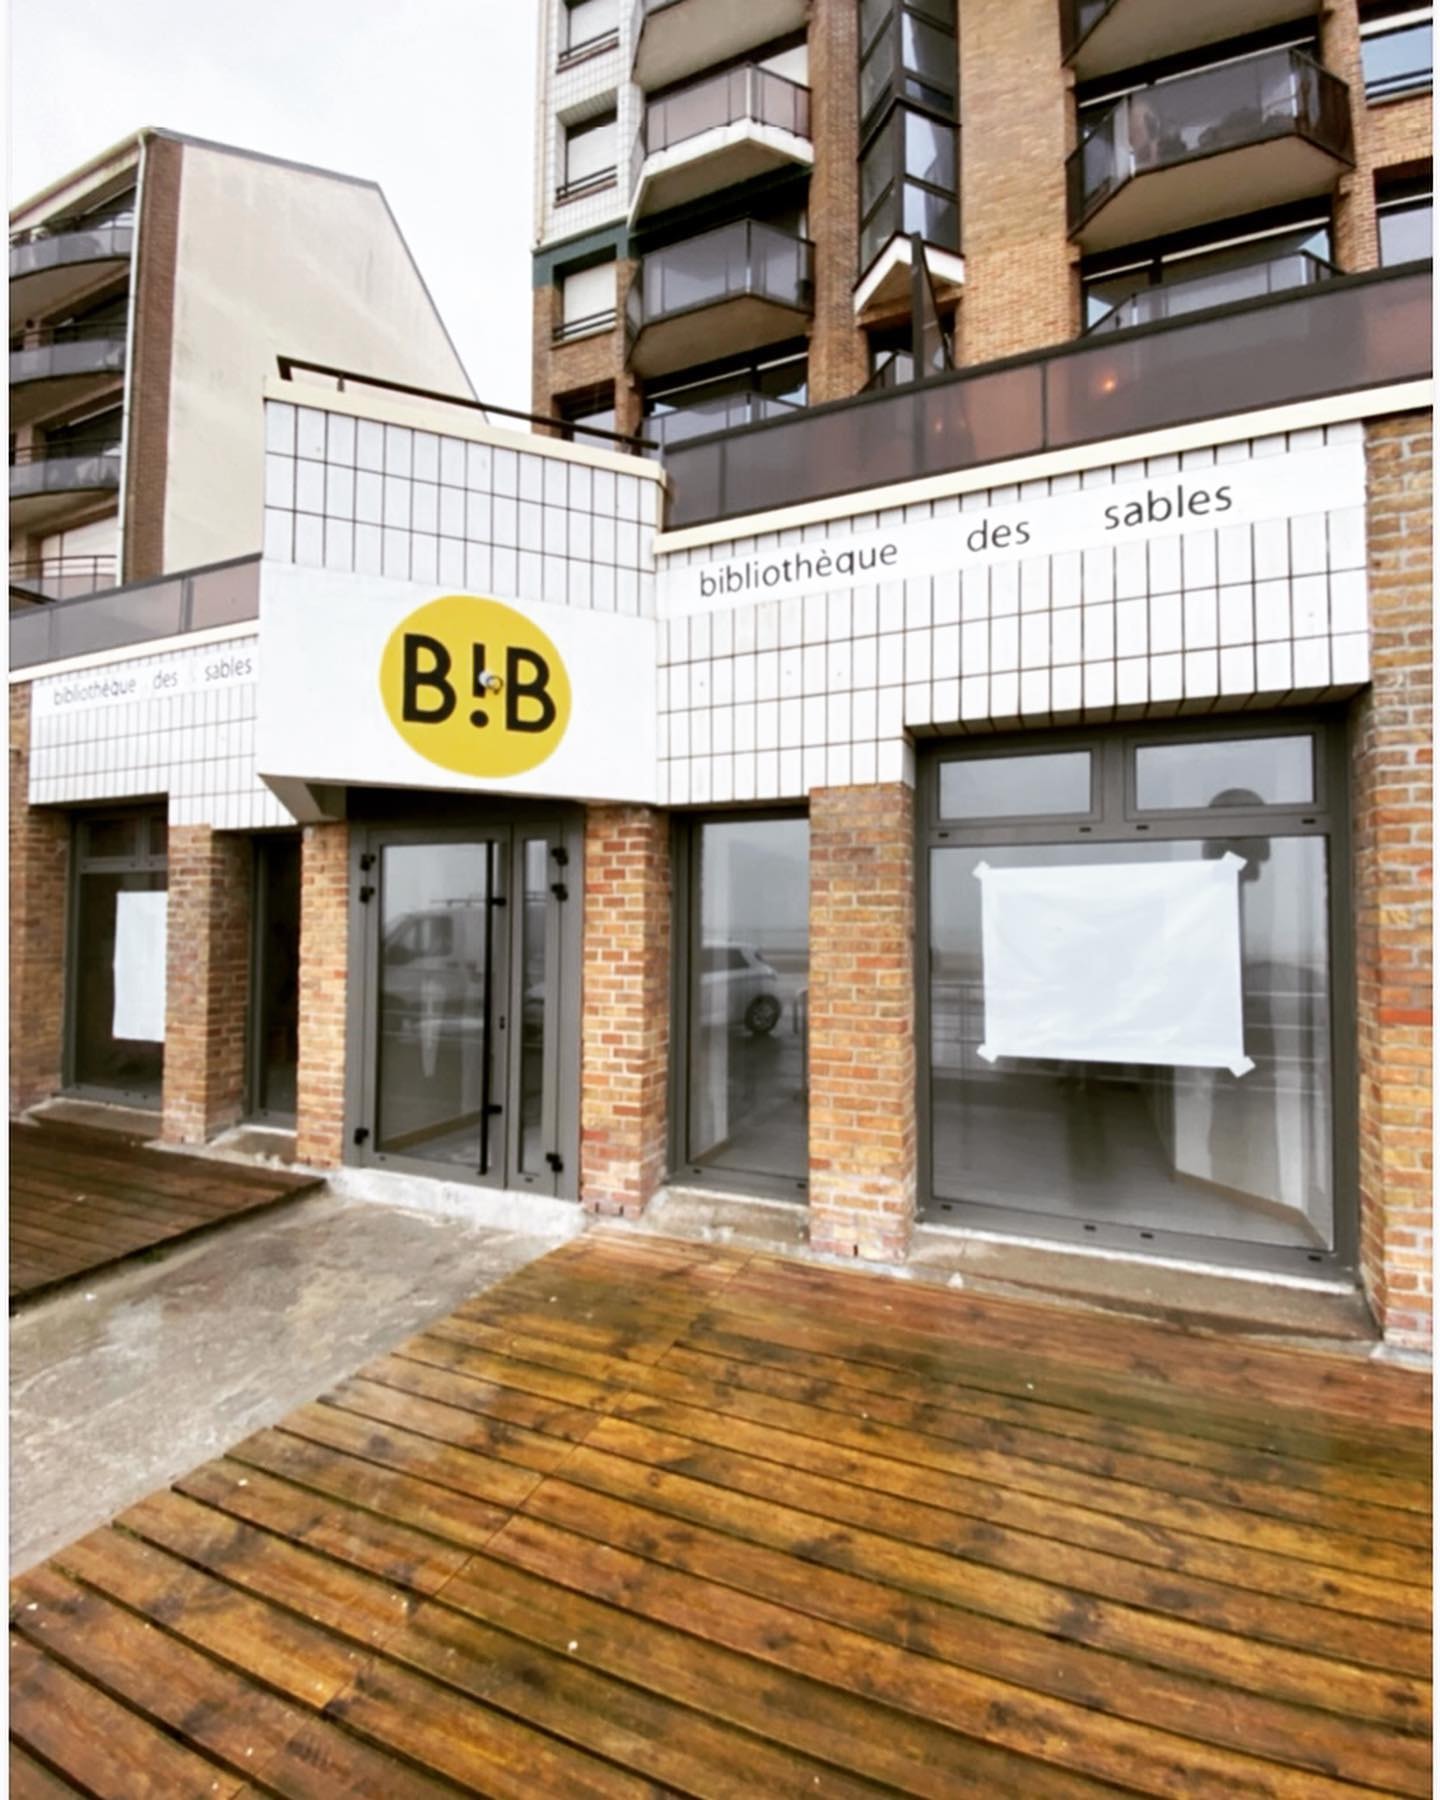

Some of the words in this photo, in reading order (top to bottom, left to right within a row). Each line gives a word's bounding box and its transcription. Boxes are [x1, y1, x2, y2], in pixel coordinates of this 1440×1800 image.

[700, 541, 898, 598] bibliothèque
[966, 518, 1031, 553] des
[1103, 483, 1234, 530] sables
[153, 670, 178, 690] des
[204, 656, 253, 682] sables
